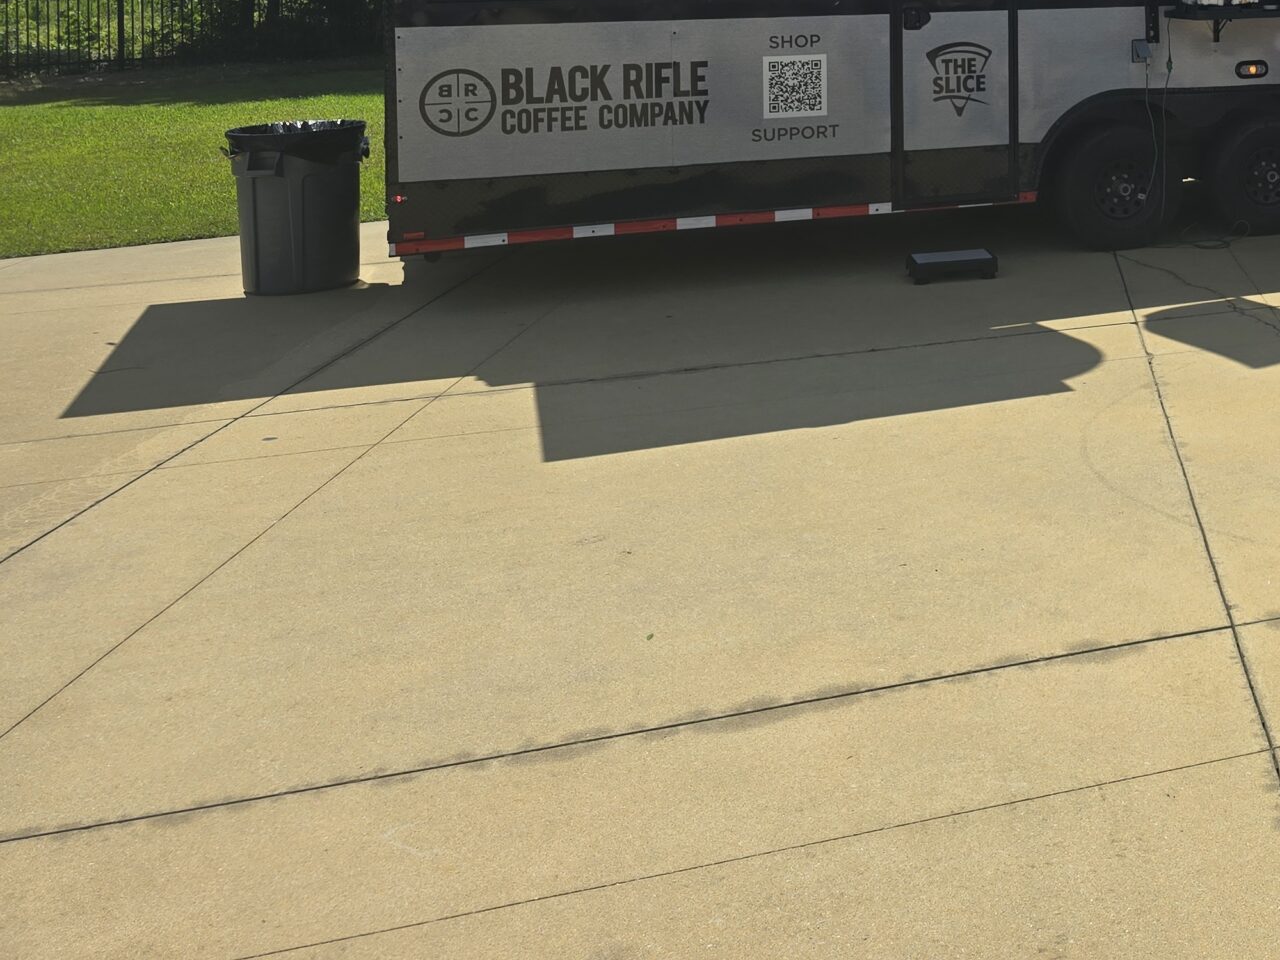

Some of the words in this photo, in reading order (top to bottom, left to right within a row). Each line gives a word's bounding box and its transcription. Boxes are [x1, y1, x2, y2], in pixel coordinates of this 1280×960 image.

[769, 34, 821, 49] SHOP
[941, 58, 977, 75] THE
[501, 63, 613, 106] BLACK
[623, 60, 710, 100] RIFLE
[932, 74, 986, 94] SLICE
[501, 105, 588, 135] COFFEE
[599, 100, 711, 130] COMPANY
[751, 124, 840, 143] SUPPORT
